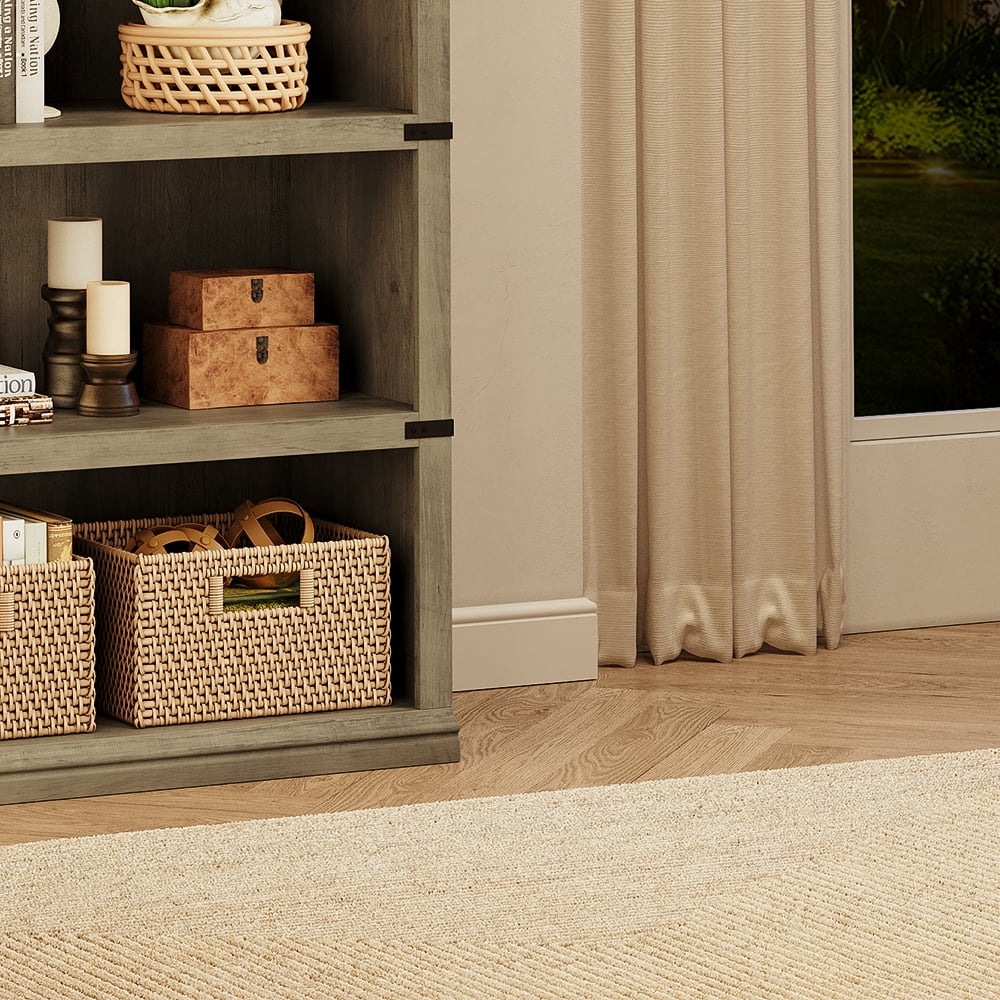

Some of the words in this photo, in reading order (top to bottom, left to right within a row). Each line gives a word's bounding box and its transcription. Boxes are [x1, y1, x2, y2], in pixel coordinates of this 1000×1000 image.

[4, 26, 11, 34] a
[29, 25, 37, 33] a
[4, 36, 13, 78] Nation
[29, 36, 40, 77] Nation
